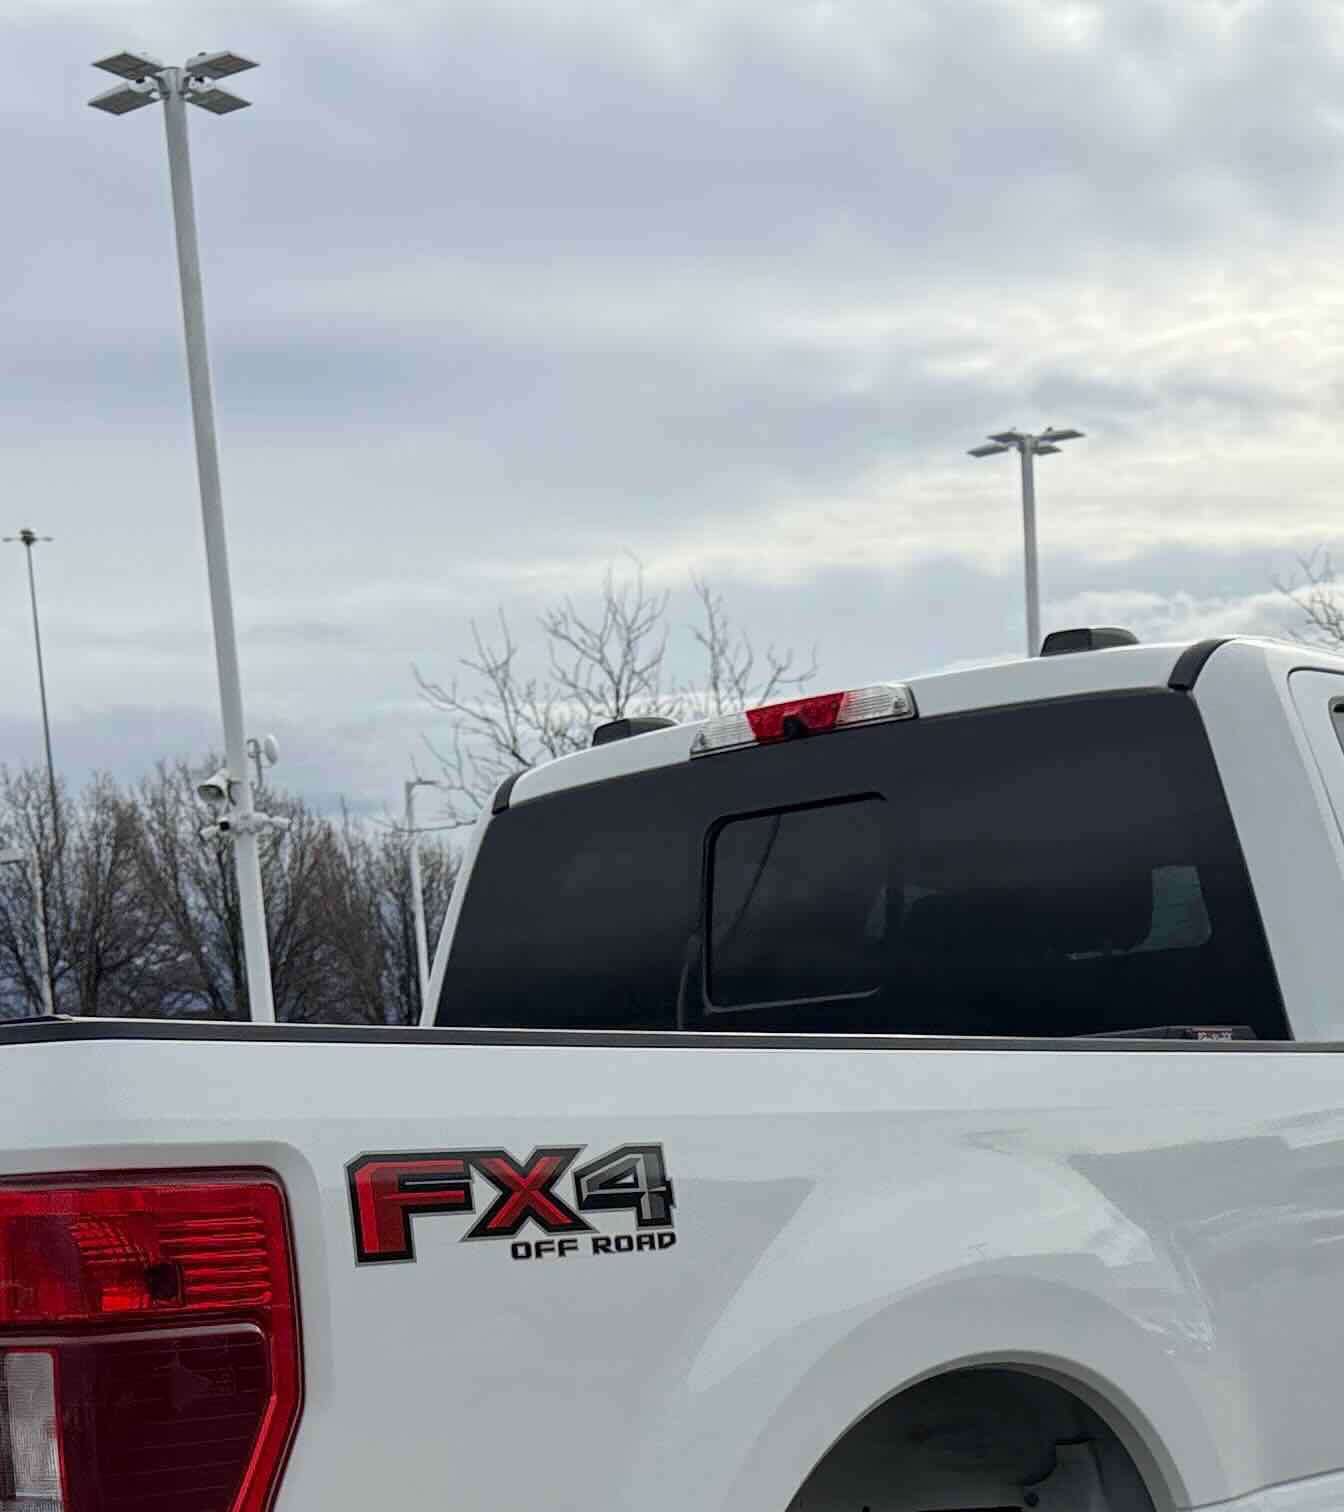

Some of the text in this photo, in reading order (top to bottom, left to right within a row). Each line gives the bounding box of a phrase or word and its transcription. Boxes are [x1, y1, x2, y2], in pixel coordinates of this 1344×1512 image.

[345, 1142, 677, 1267] FX4
[511, 1232, 677, 1260] OFF ROAD
